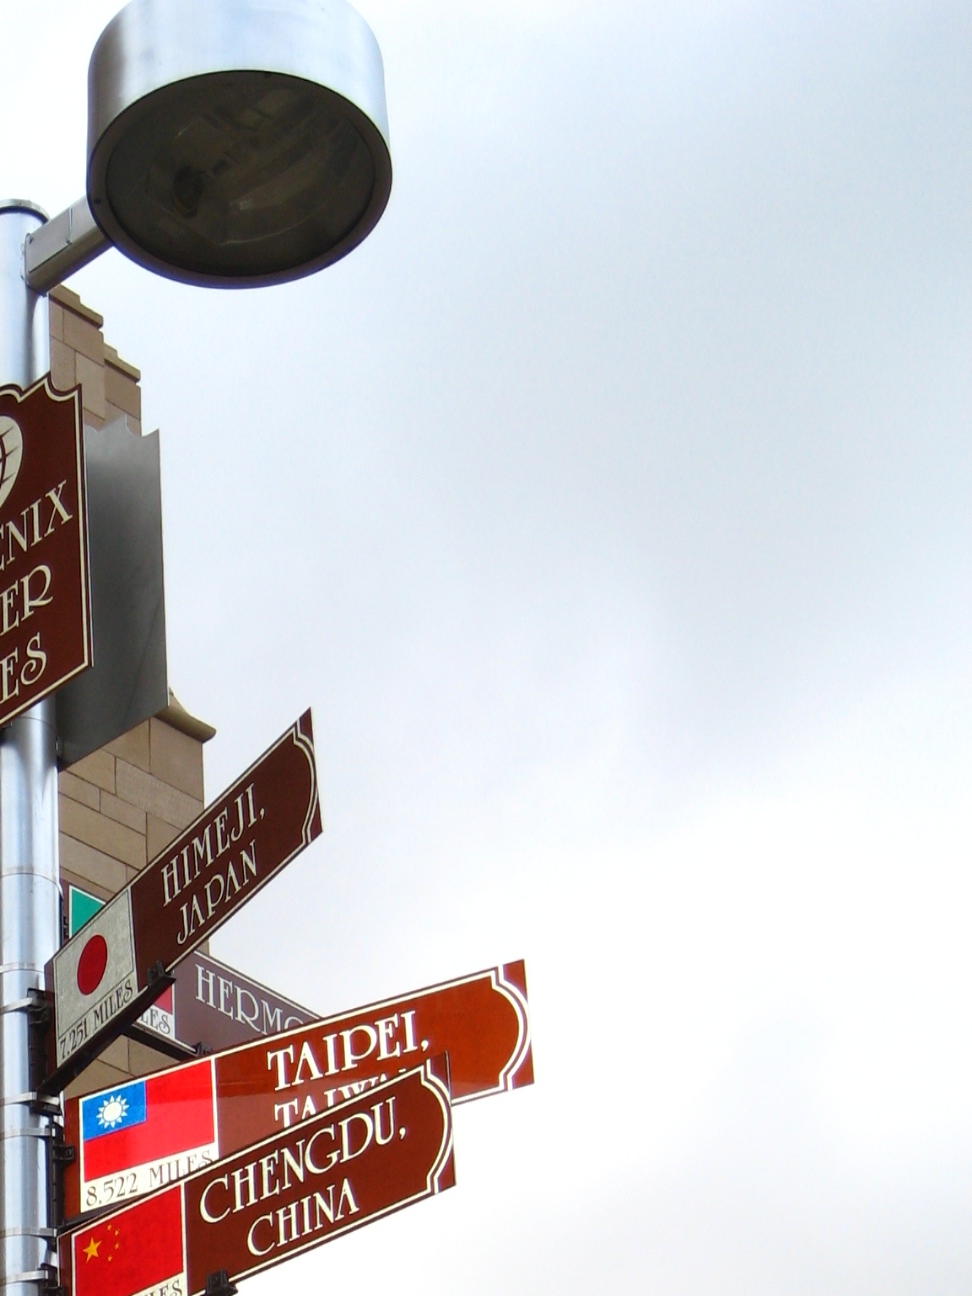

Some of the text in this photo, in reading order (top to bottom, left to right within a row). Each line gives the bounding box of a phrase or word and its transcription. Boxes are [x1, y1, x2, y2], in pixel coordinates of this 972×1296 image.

[160, 783, 266, 907] HIMEJI,
[177, 839, 258, 944] JAPAN
[93, 979, 133, 1031] MILES
[267, 1010, 429, 1091] TAIPEI,
[198, 1097, 407, 1225] CHENGDU,
[246, 1179, 360, 1257] CHINA
